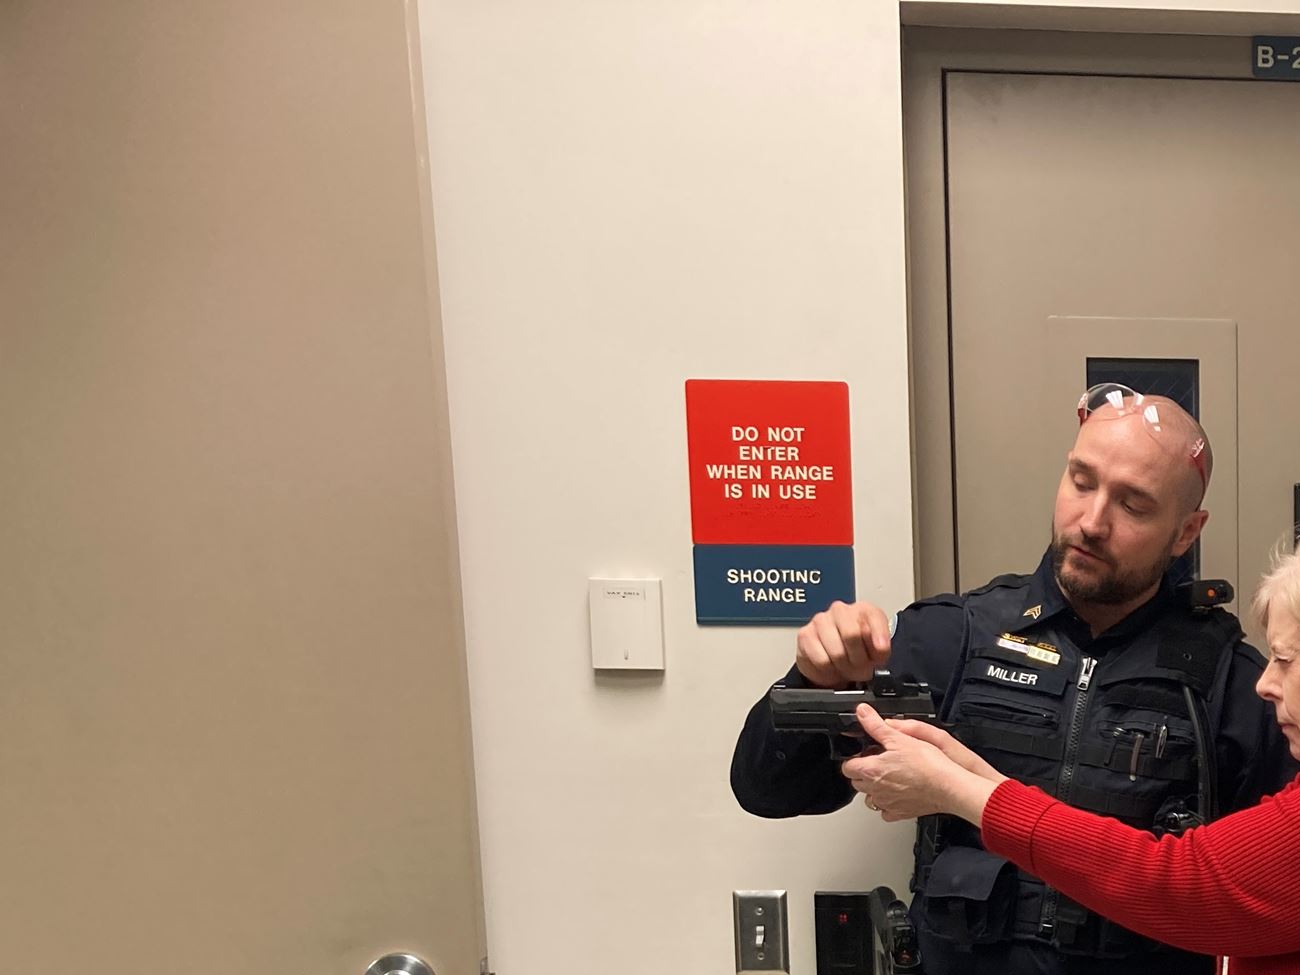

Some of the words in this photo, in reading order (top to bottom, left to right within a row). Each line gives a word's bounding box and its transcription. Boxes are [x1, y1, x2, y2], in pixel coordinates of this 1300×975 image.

[731, 426, 759, 442] DO
[767, 427, 805, 443] NOT
[738, 446, 800, 462] ENTER
[705, 464, 762, 480] WHEN
[770, 466, 834, 481] RANGE
[724, 484, 743, 499] IS
[751, 484, 770, 499] IN
[779, 485, 817, 500] USE
[727, 568, 821, 584] SHOOTING
[743, 587, 807, 602] RANGE
[986, 664, 1039, 686] MILLER
